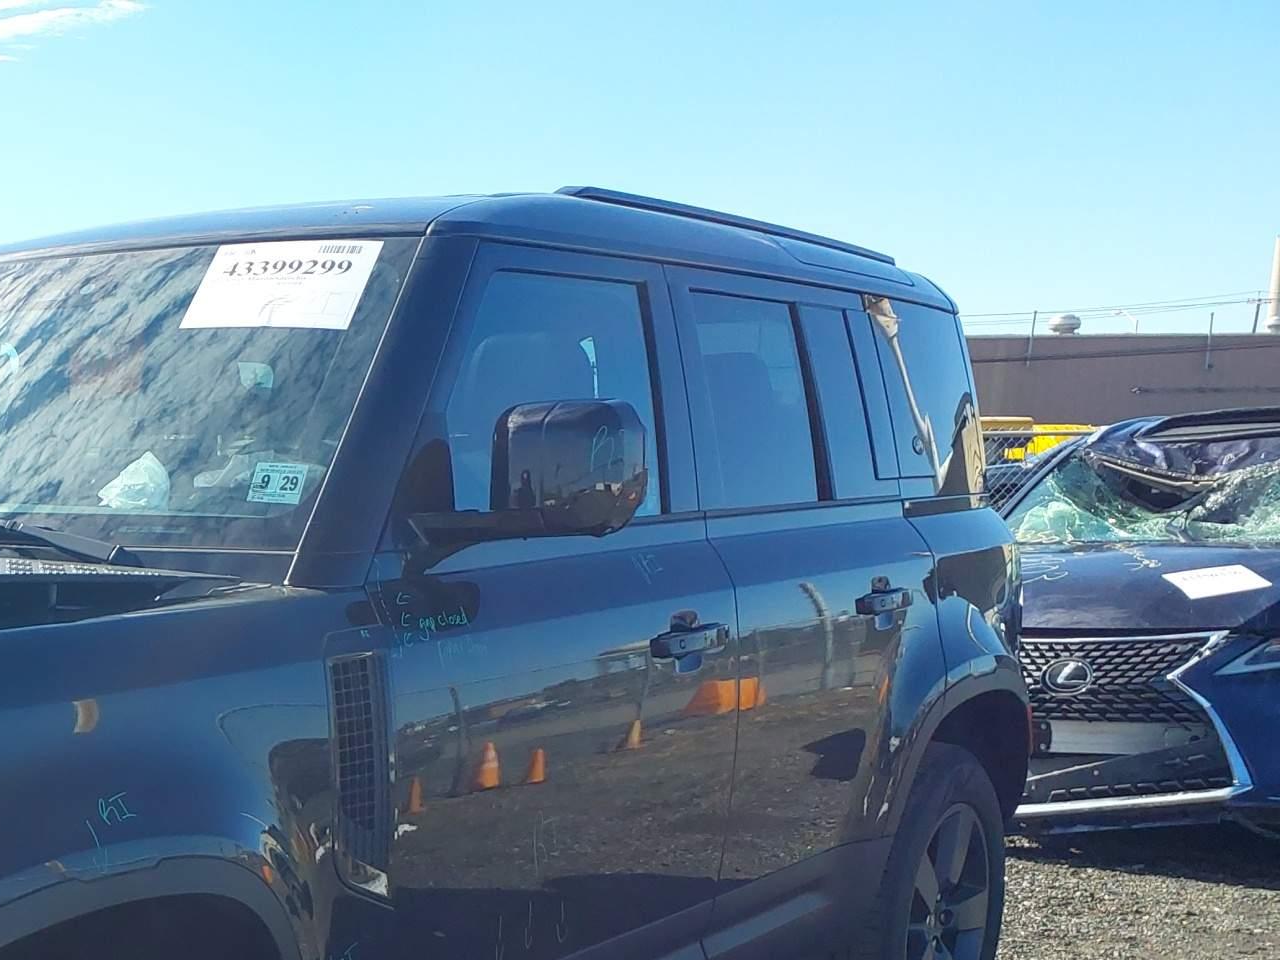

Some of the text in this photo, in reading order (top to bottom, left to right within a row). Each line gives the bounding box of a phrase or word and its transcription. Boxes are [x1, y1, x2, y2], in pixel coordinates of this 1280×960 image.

[223, 258, 353, 277] 43399299
[261, 473, 299, 491] 9 29
